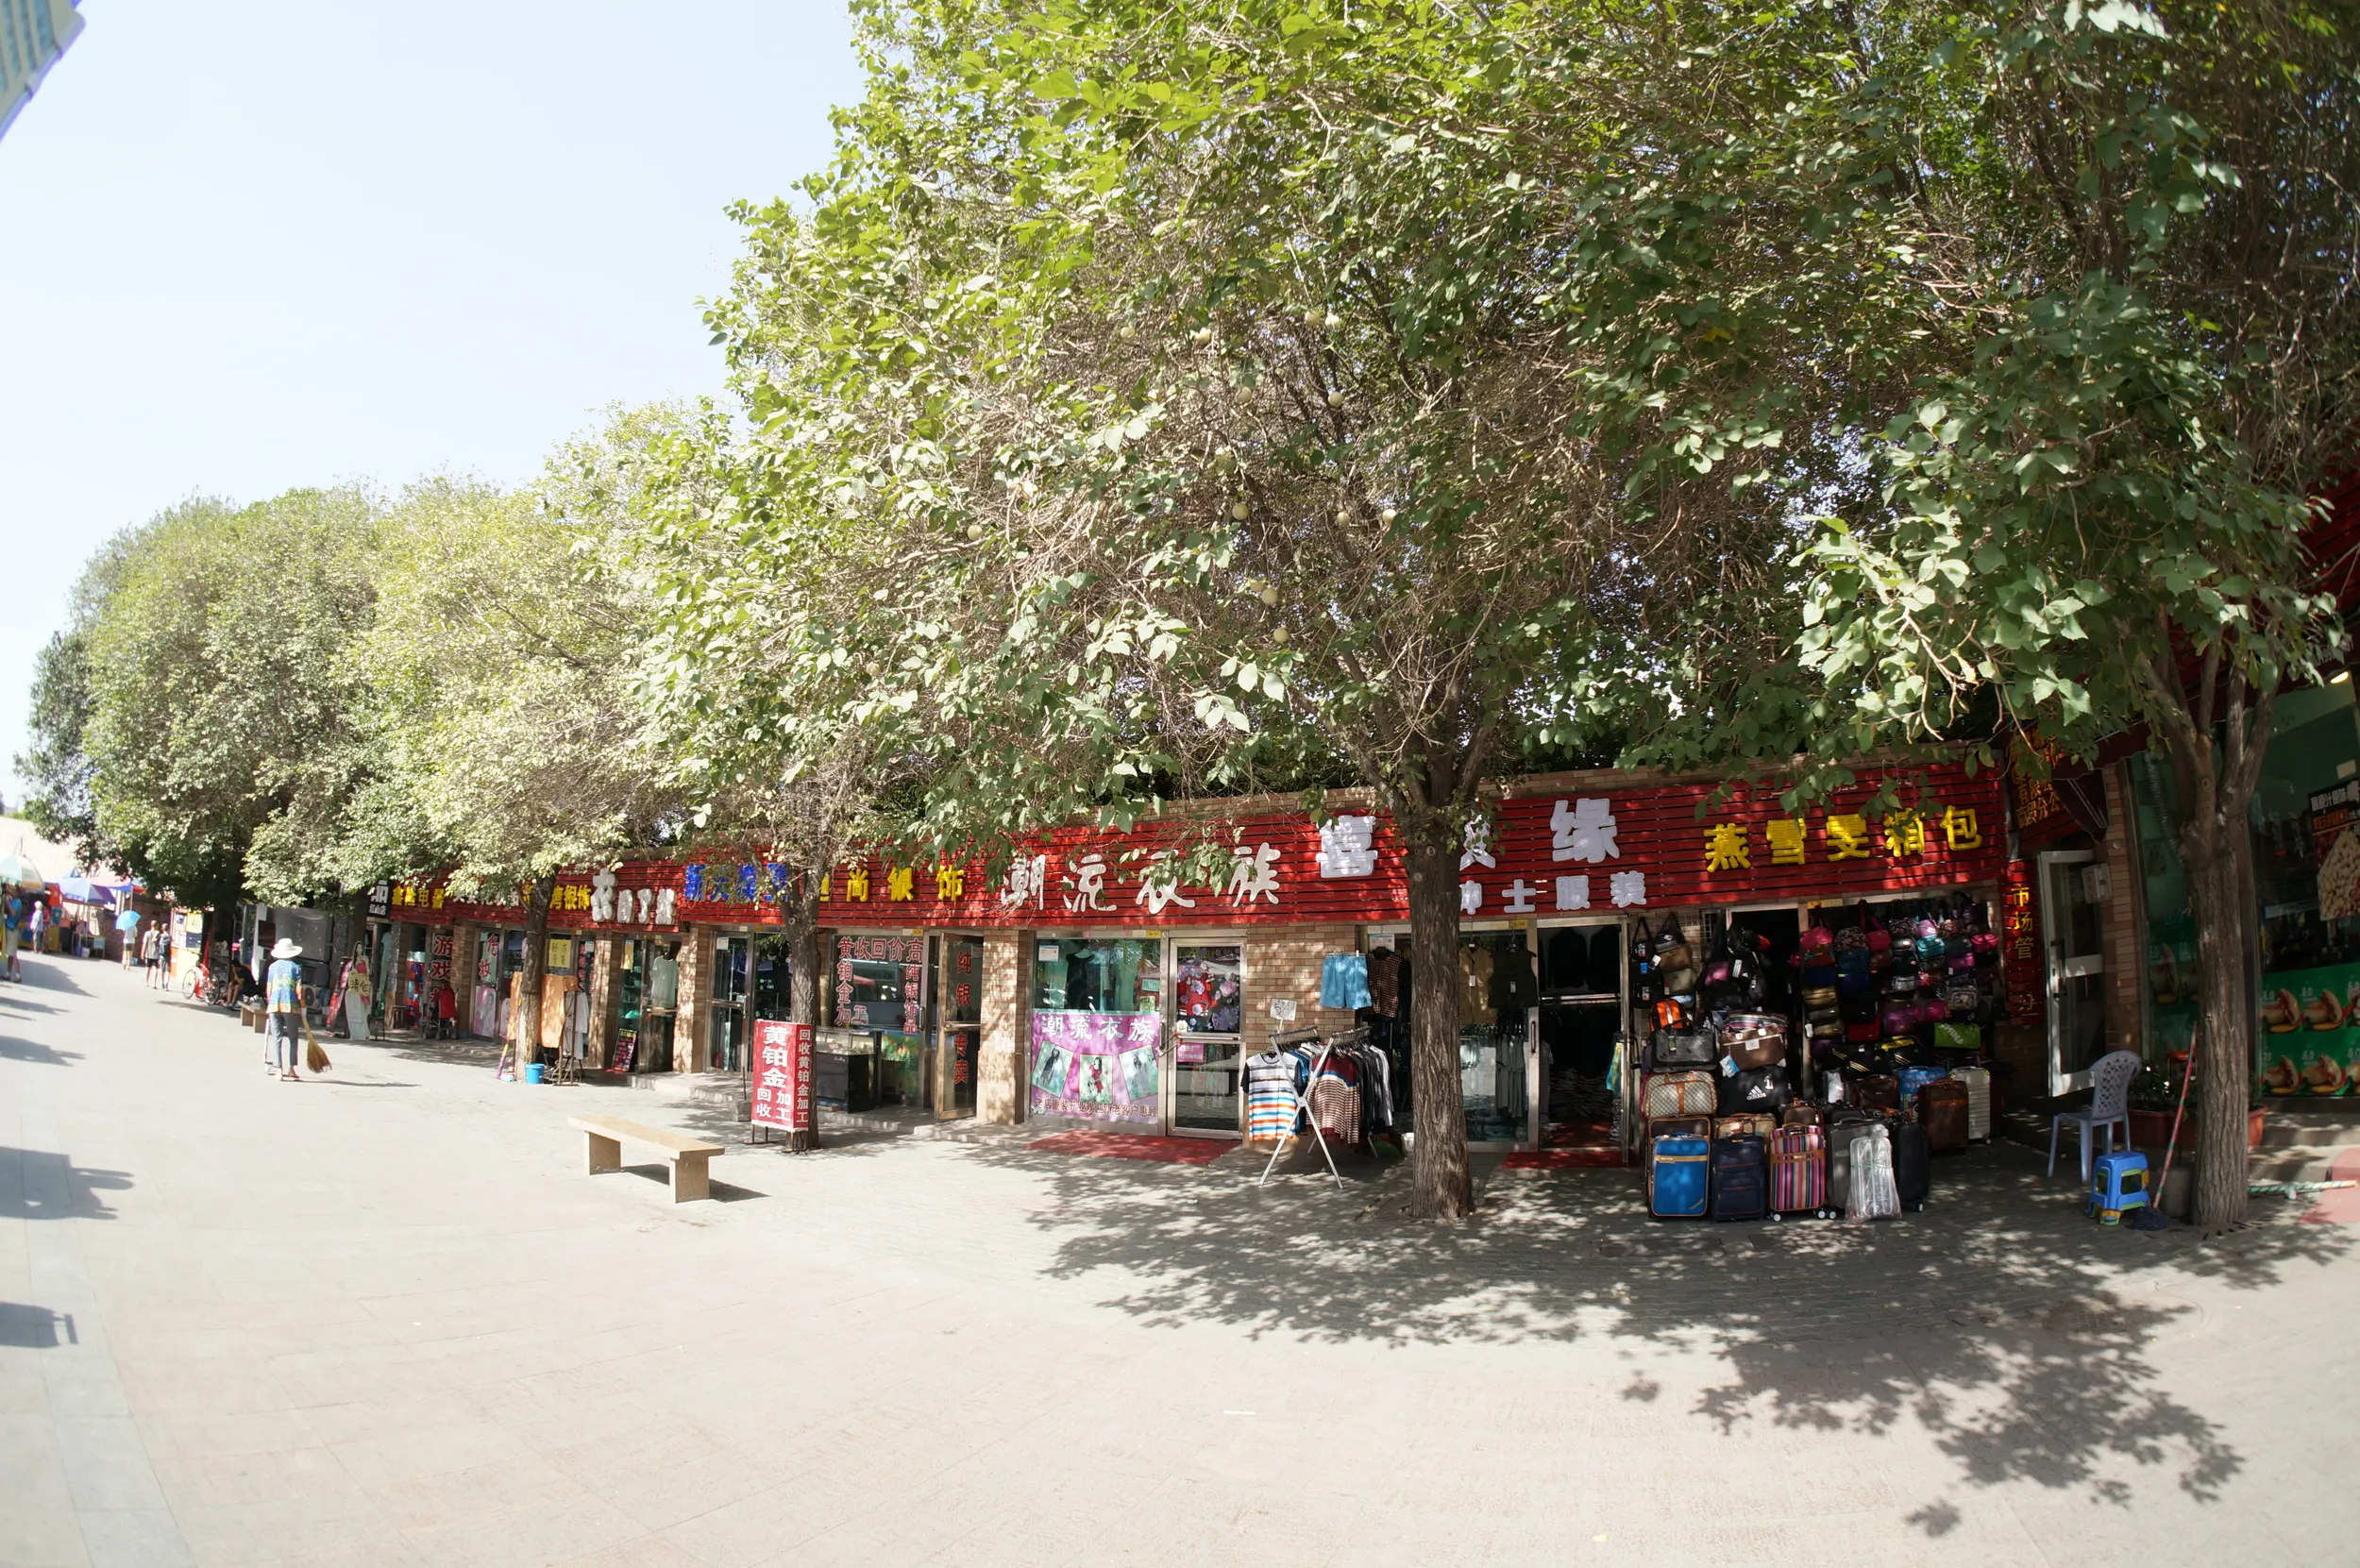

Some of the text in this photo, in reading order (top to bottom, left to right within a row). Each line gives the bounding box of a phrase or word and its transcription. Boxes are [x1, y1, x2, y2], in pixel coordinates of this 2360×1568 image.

[761, 1025, 790, 1088] 黄铂金
[1041, 1015, 1155, 1042] 潮流衣族
[797, 1029, 811, 1123] 回收黄铂金加工
